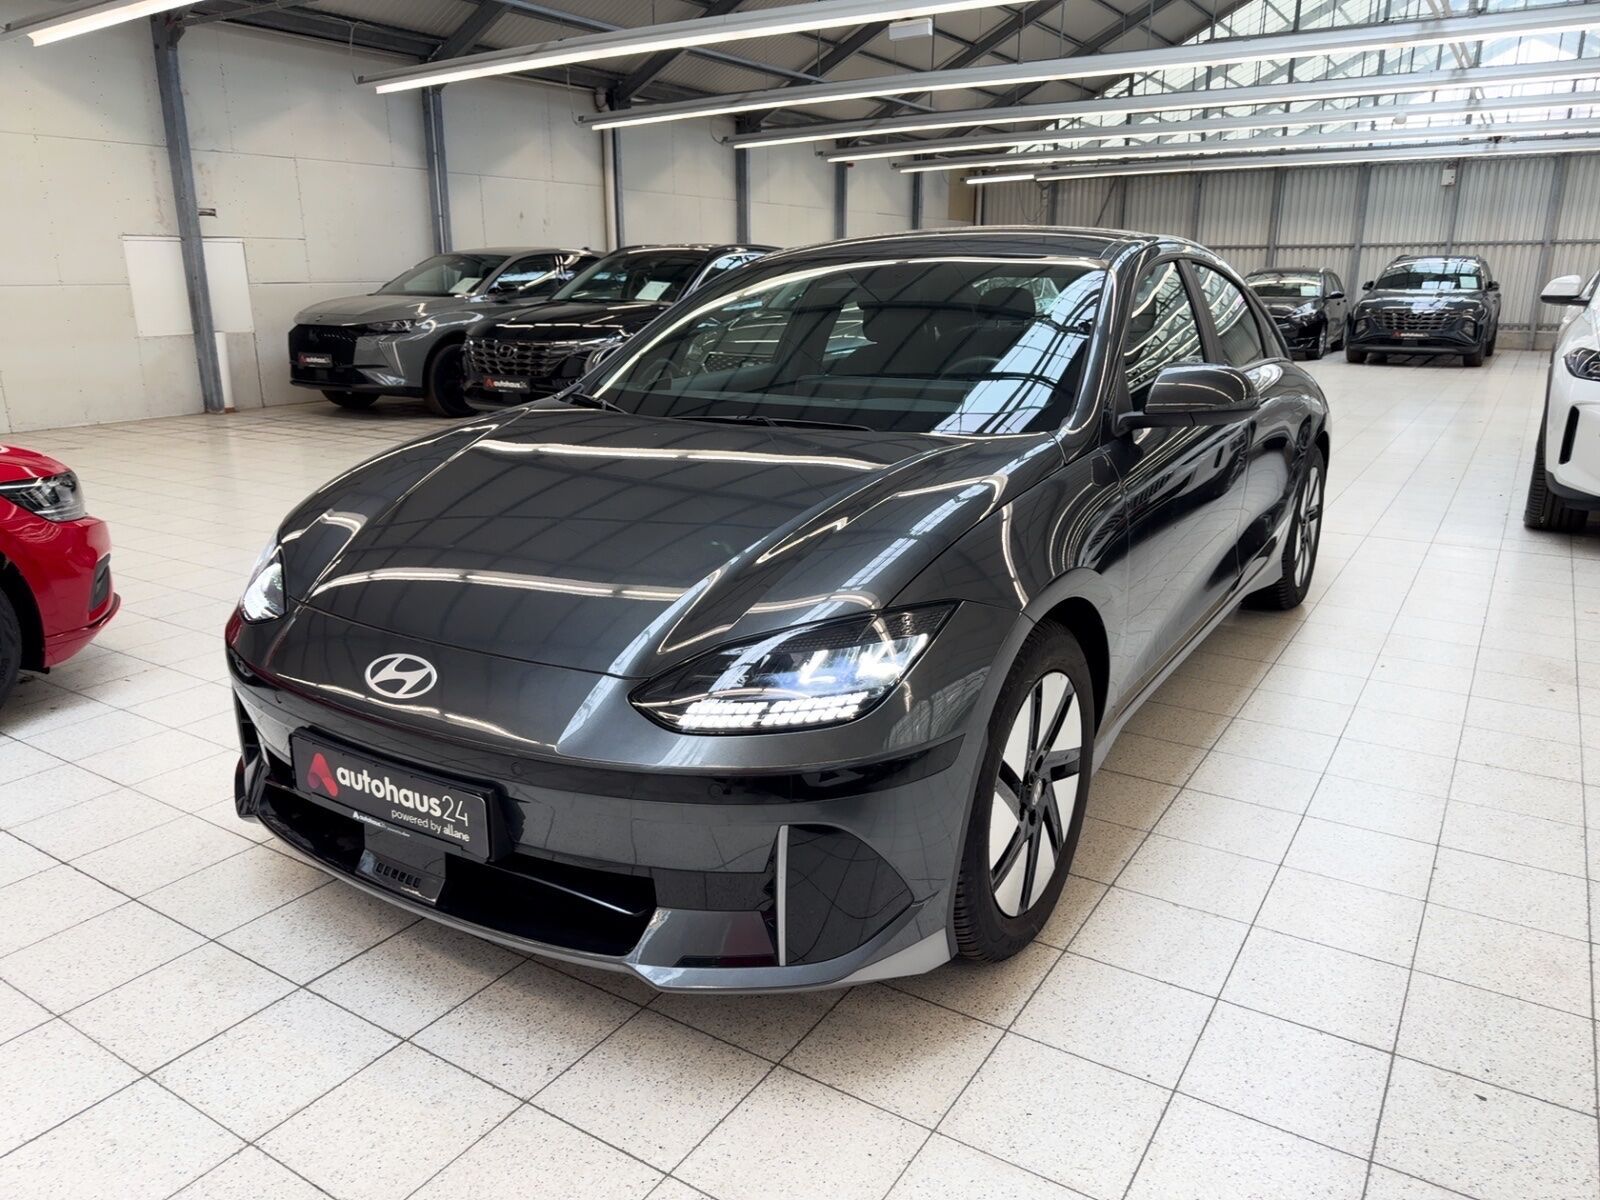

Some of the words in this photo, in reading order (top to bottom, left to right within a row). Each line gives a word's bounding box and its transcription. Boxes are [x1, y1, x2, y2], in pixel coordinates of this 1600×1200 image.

[336, 766, 469, 827] autohaus24
[391, 809, 429, 829] powered
[430, 819, 442, 835] by
[443, 823, 470, 842] allane
